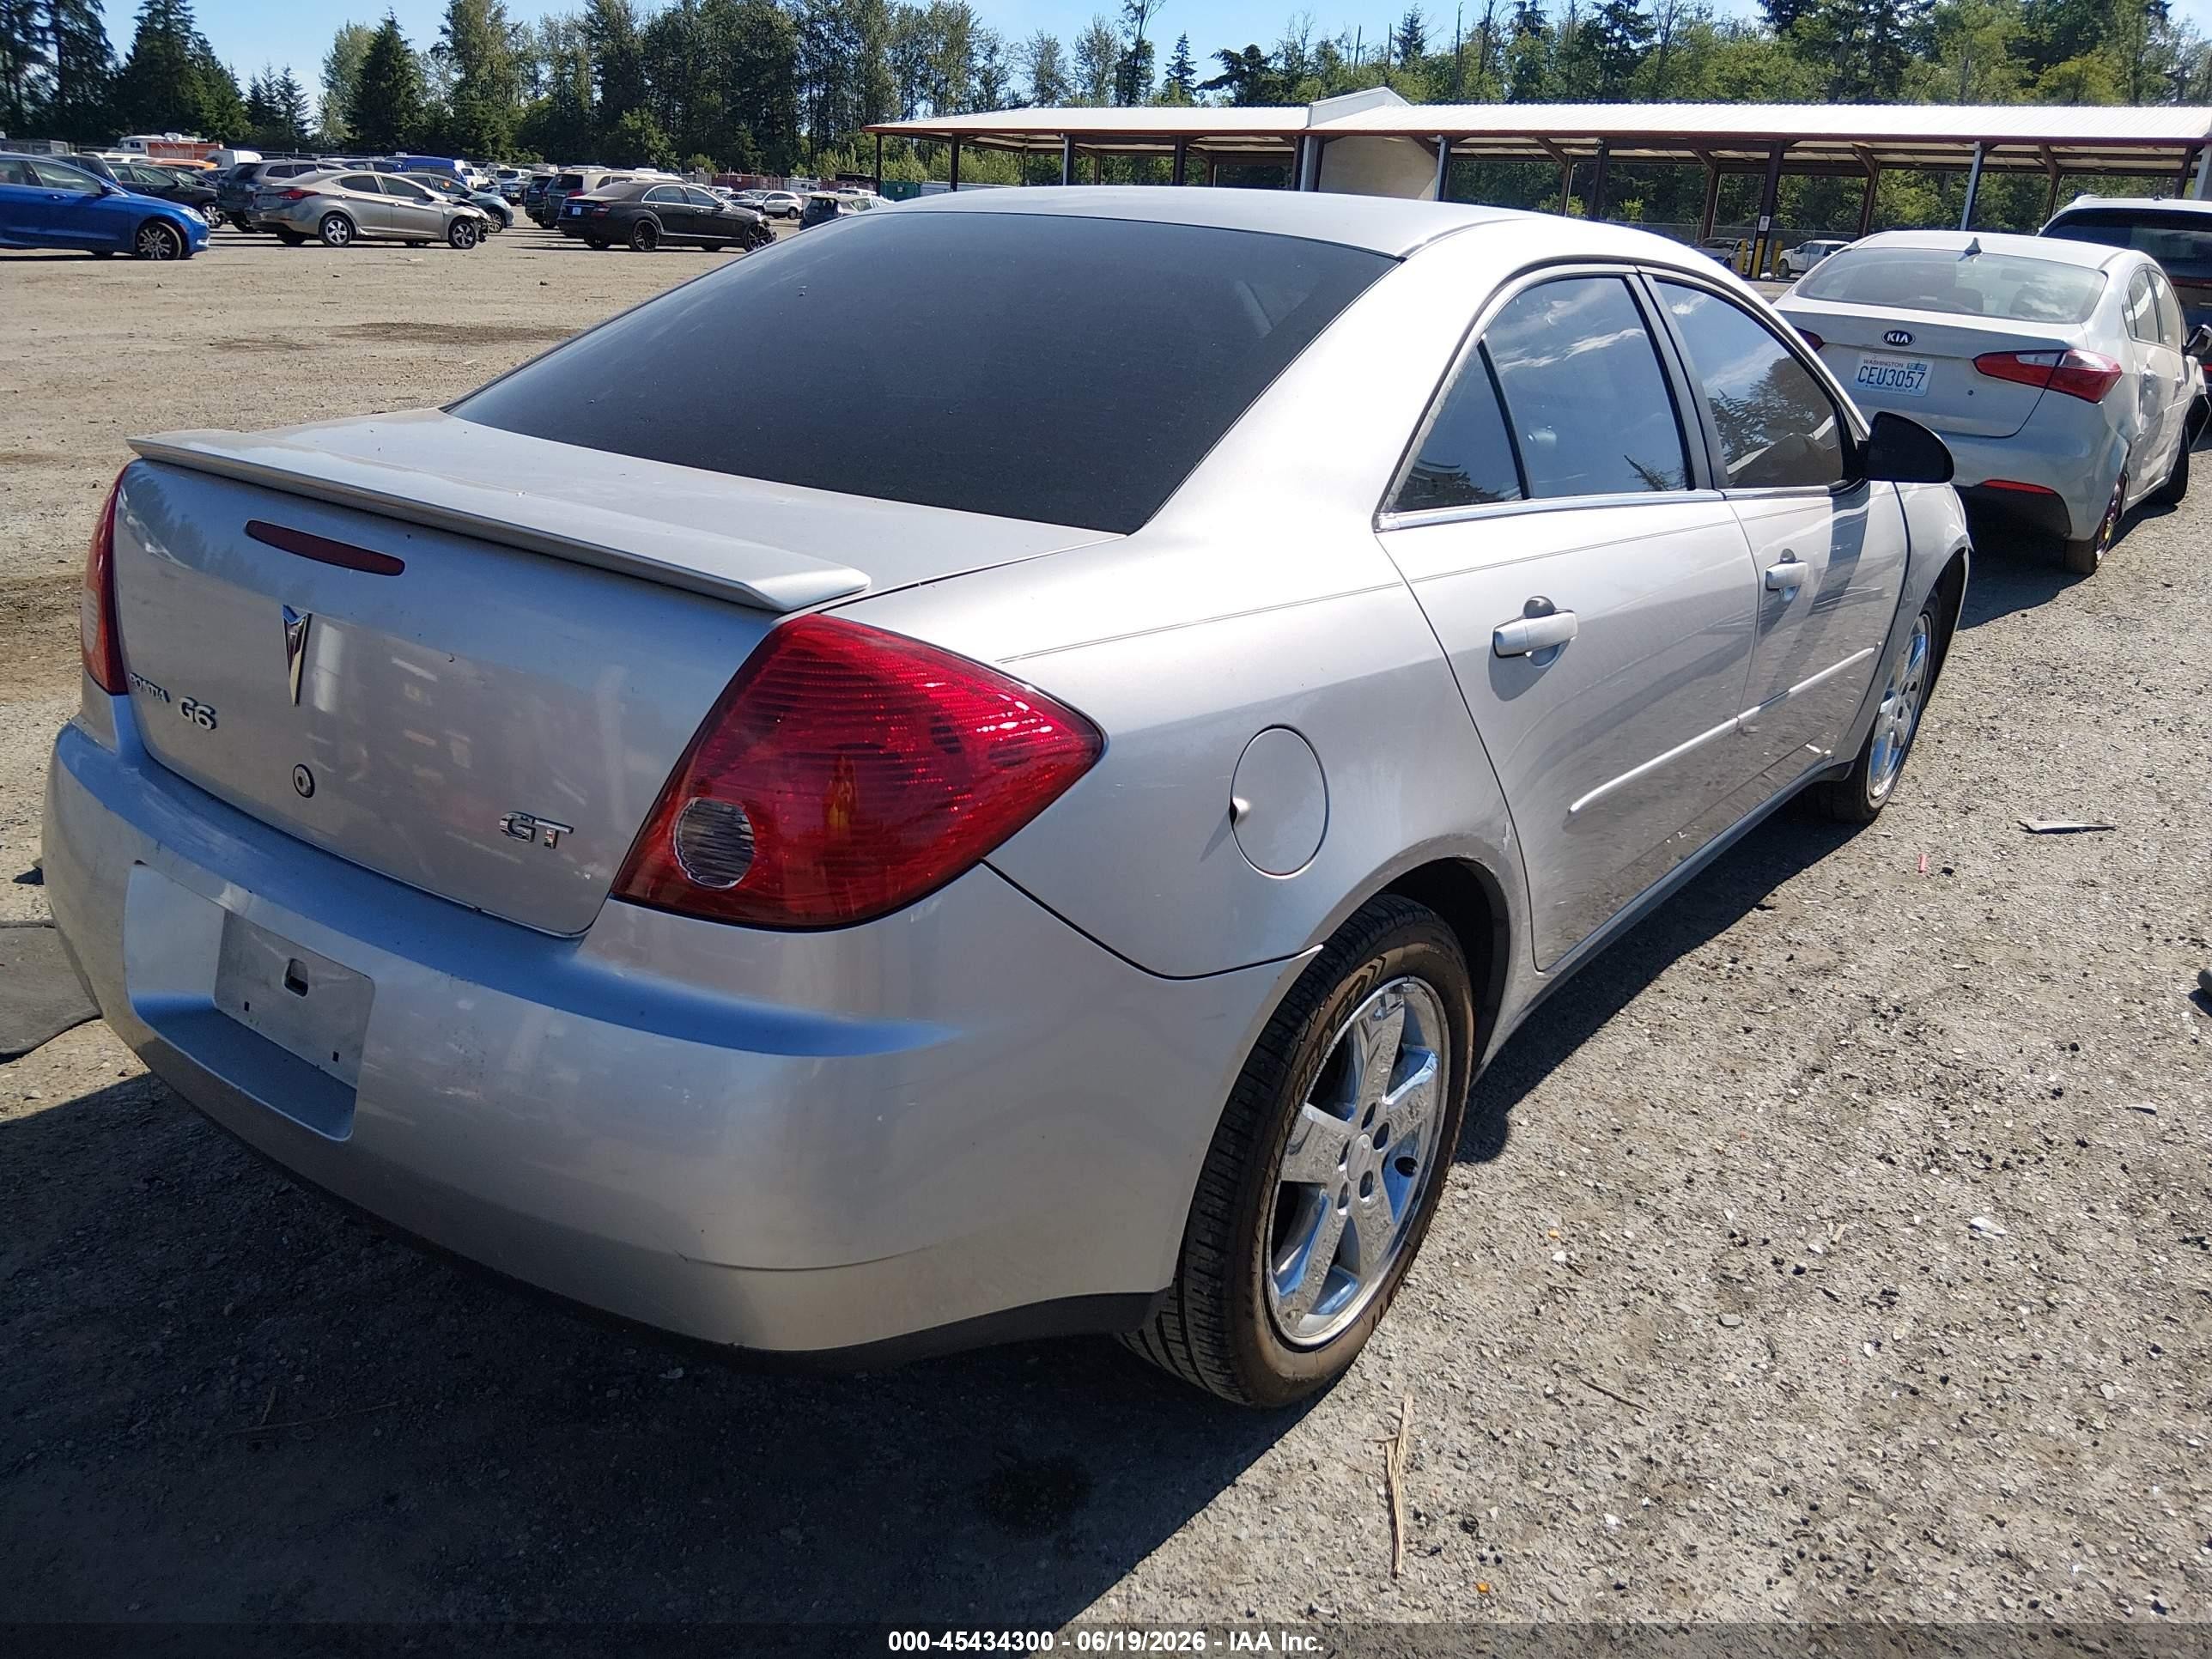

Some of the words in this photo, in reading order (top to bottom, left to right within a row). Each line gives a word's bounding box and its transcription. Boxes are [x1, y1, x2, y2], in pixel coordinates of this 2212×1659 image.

[1887, 332, 1909, 343] KIA
[1863, 359, 1904, 368] WASHINGTON
[1857, 366, 1925, 389] CEU3057
[178, 696, 216, 730] G6
[499, 811, 574, 849] GT
